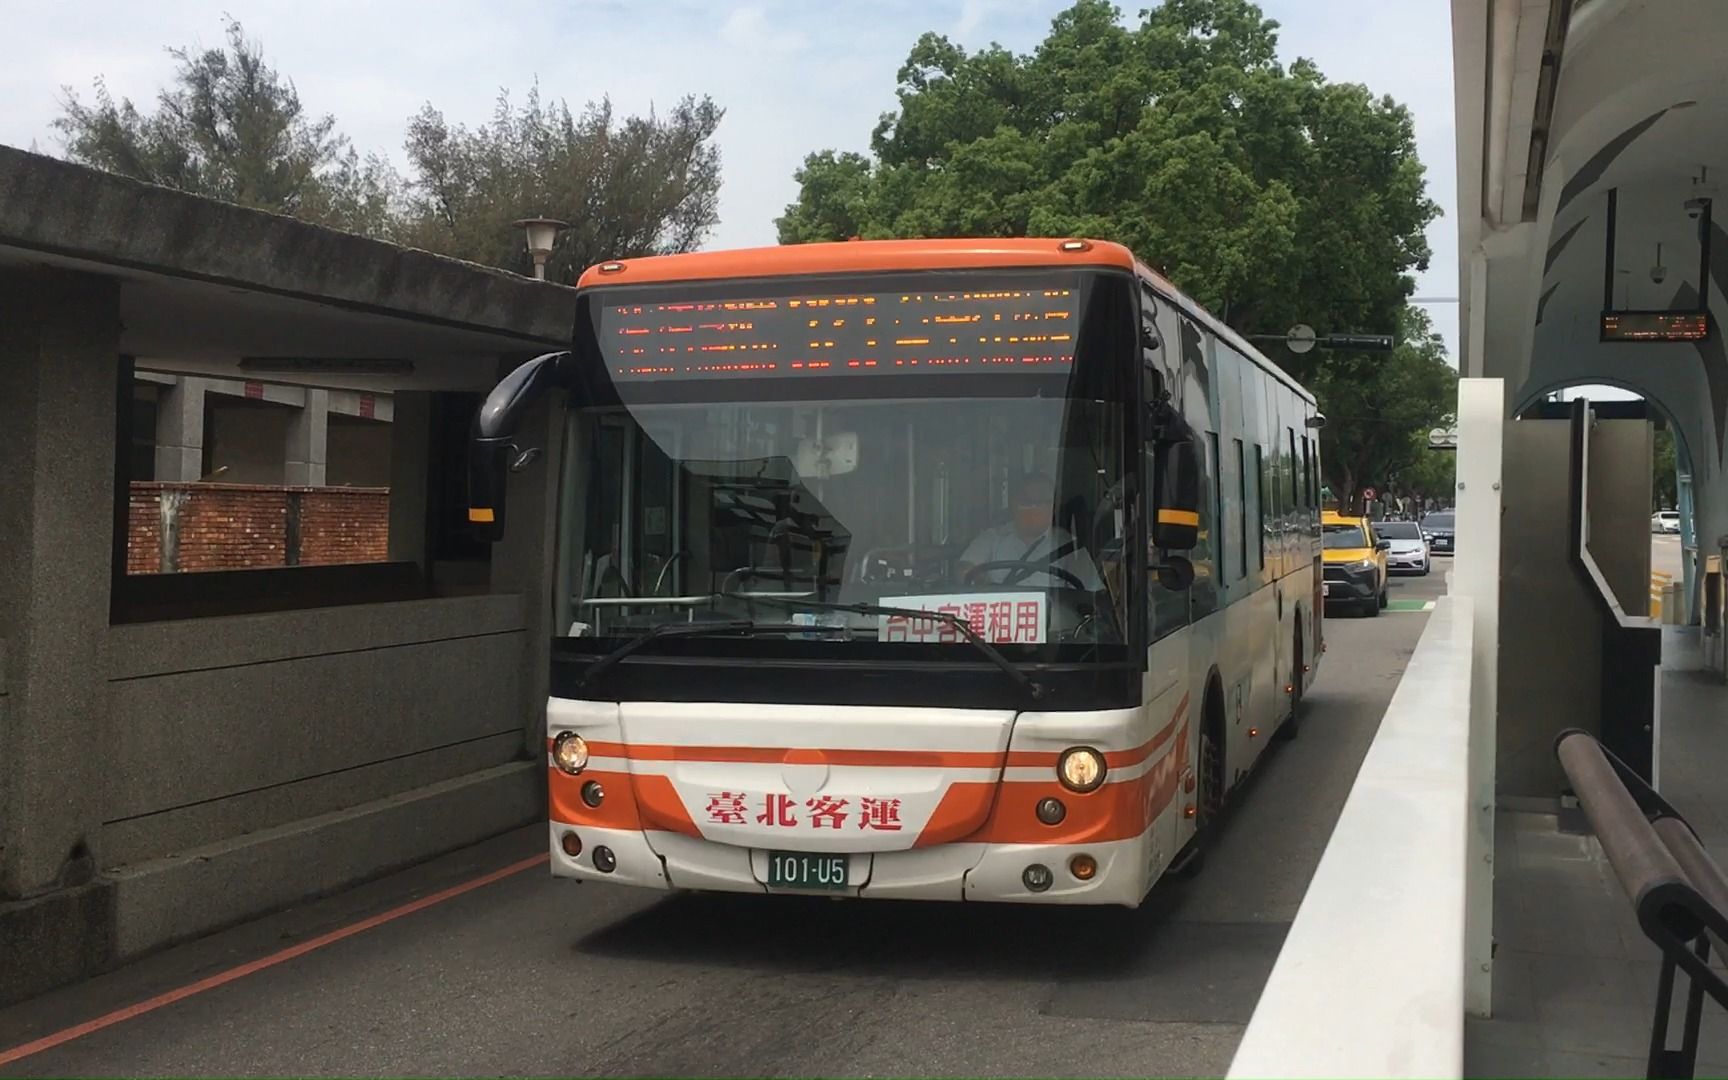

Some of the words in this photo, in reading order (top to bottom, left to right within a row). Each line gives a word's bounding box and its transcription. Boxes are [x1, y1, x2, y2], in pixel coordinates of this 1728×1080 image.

[705, 791, 903, 831] 臺北客運
[774, 856, 845, 884] 101-U5
